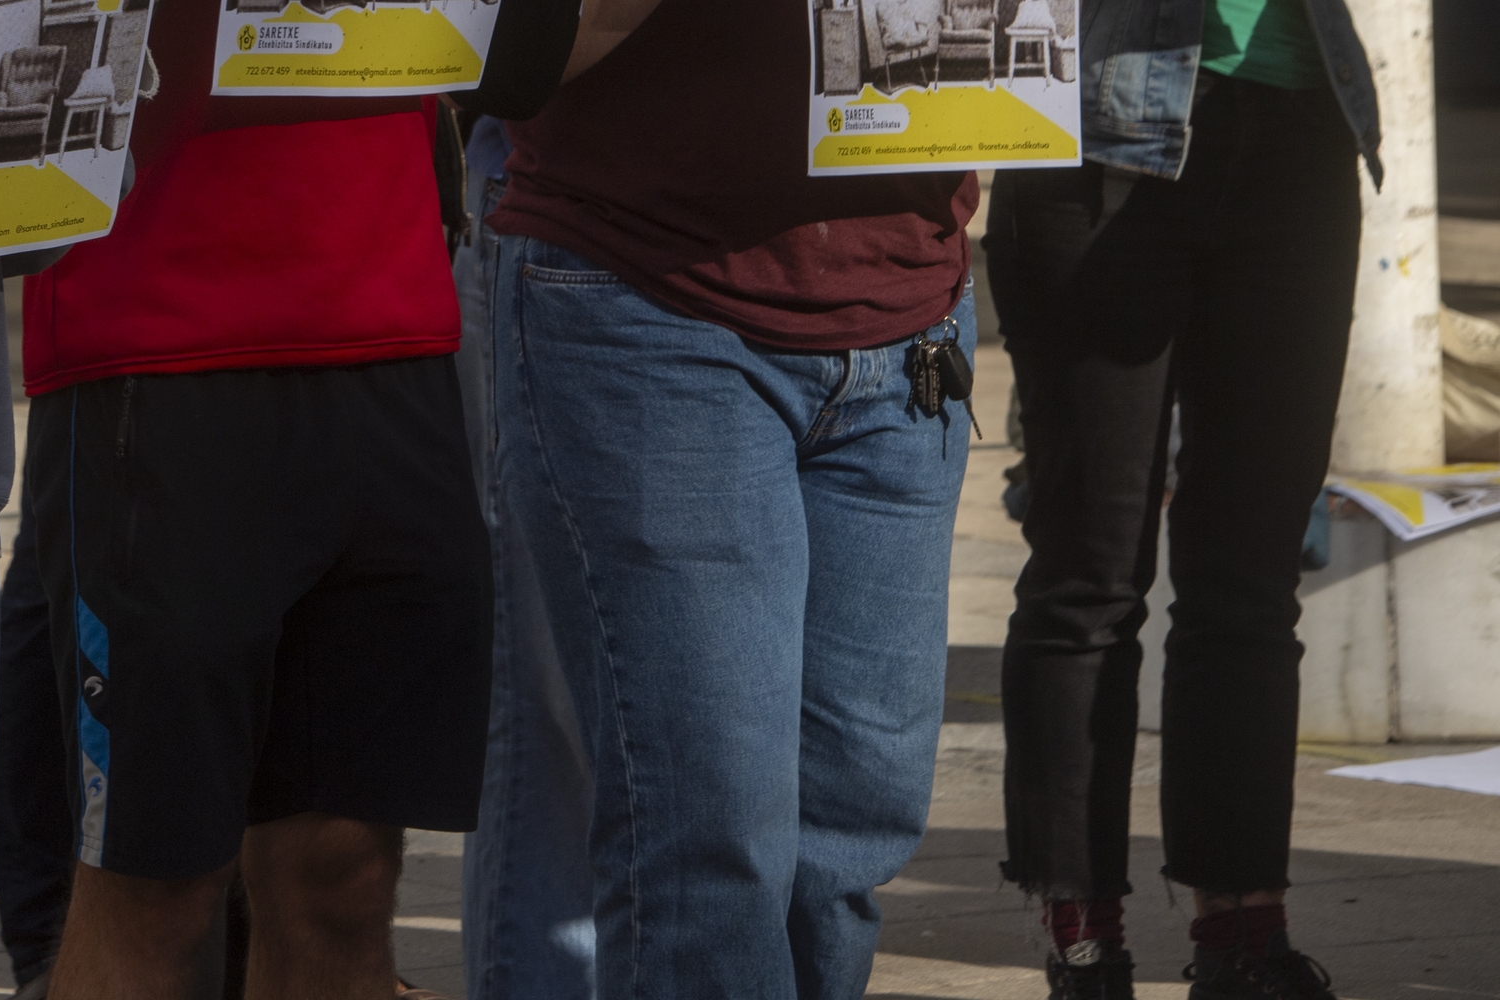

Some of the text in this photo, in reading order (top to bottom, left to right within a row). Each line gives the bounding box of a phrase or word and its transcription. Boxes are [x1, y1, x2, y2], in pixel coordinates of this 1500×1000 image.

[260, 27, 299, 38] SARETXE
[258, 40, 332, 49] Etxebizitza Sindikatua
